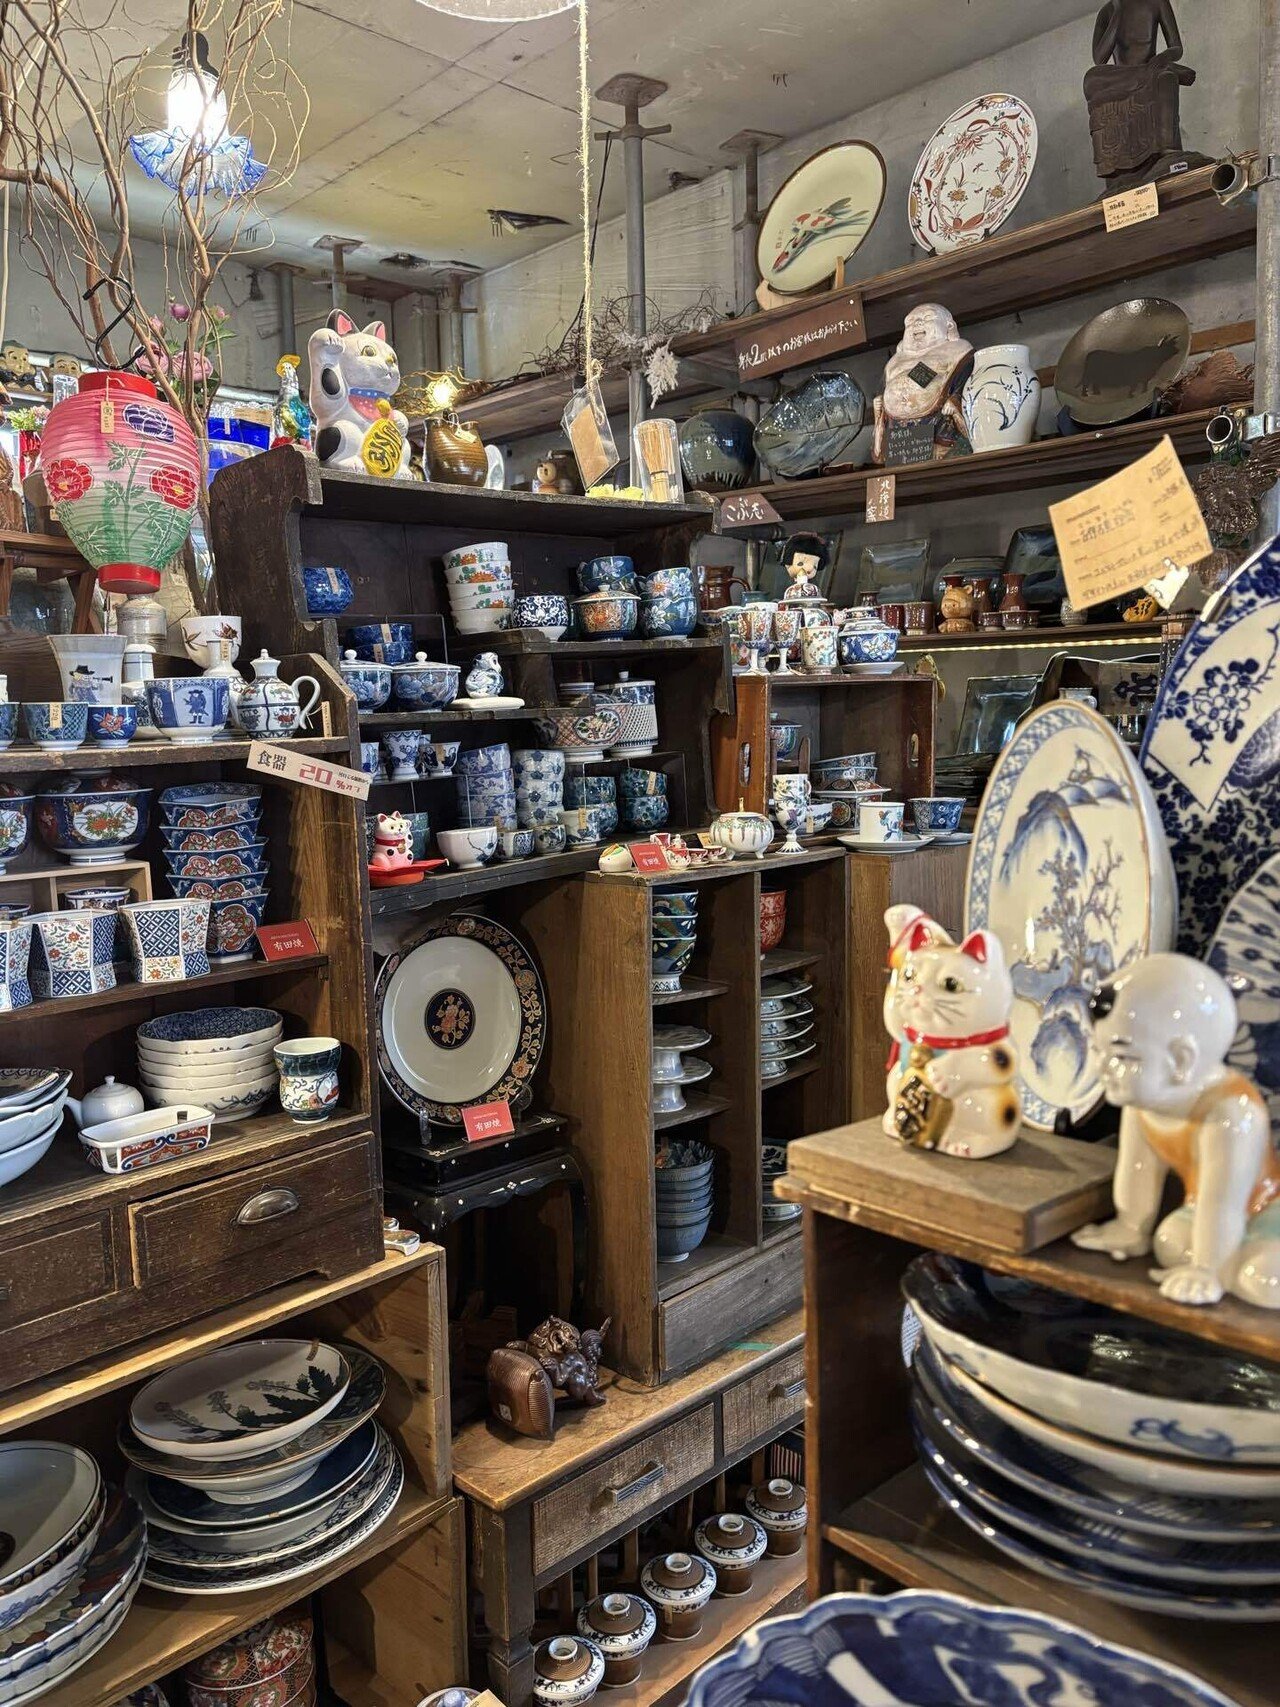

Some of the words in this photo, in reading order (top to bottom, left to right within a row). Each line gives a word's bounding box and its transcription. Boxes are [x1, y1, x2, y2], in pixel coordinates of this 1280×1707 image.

[726, 497, 765, 521] こぶ志
[257, 750, 287, 771] 食器
[273, 938, 305, 952] 有田焼
[474, 1117, 502, 1132] 有田焼
